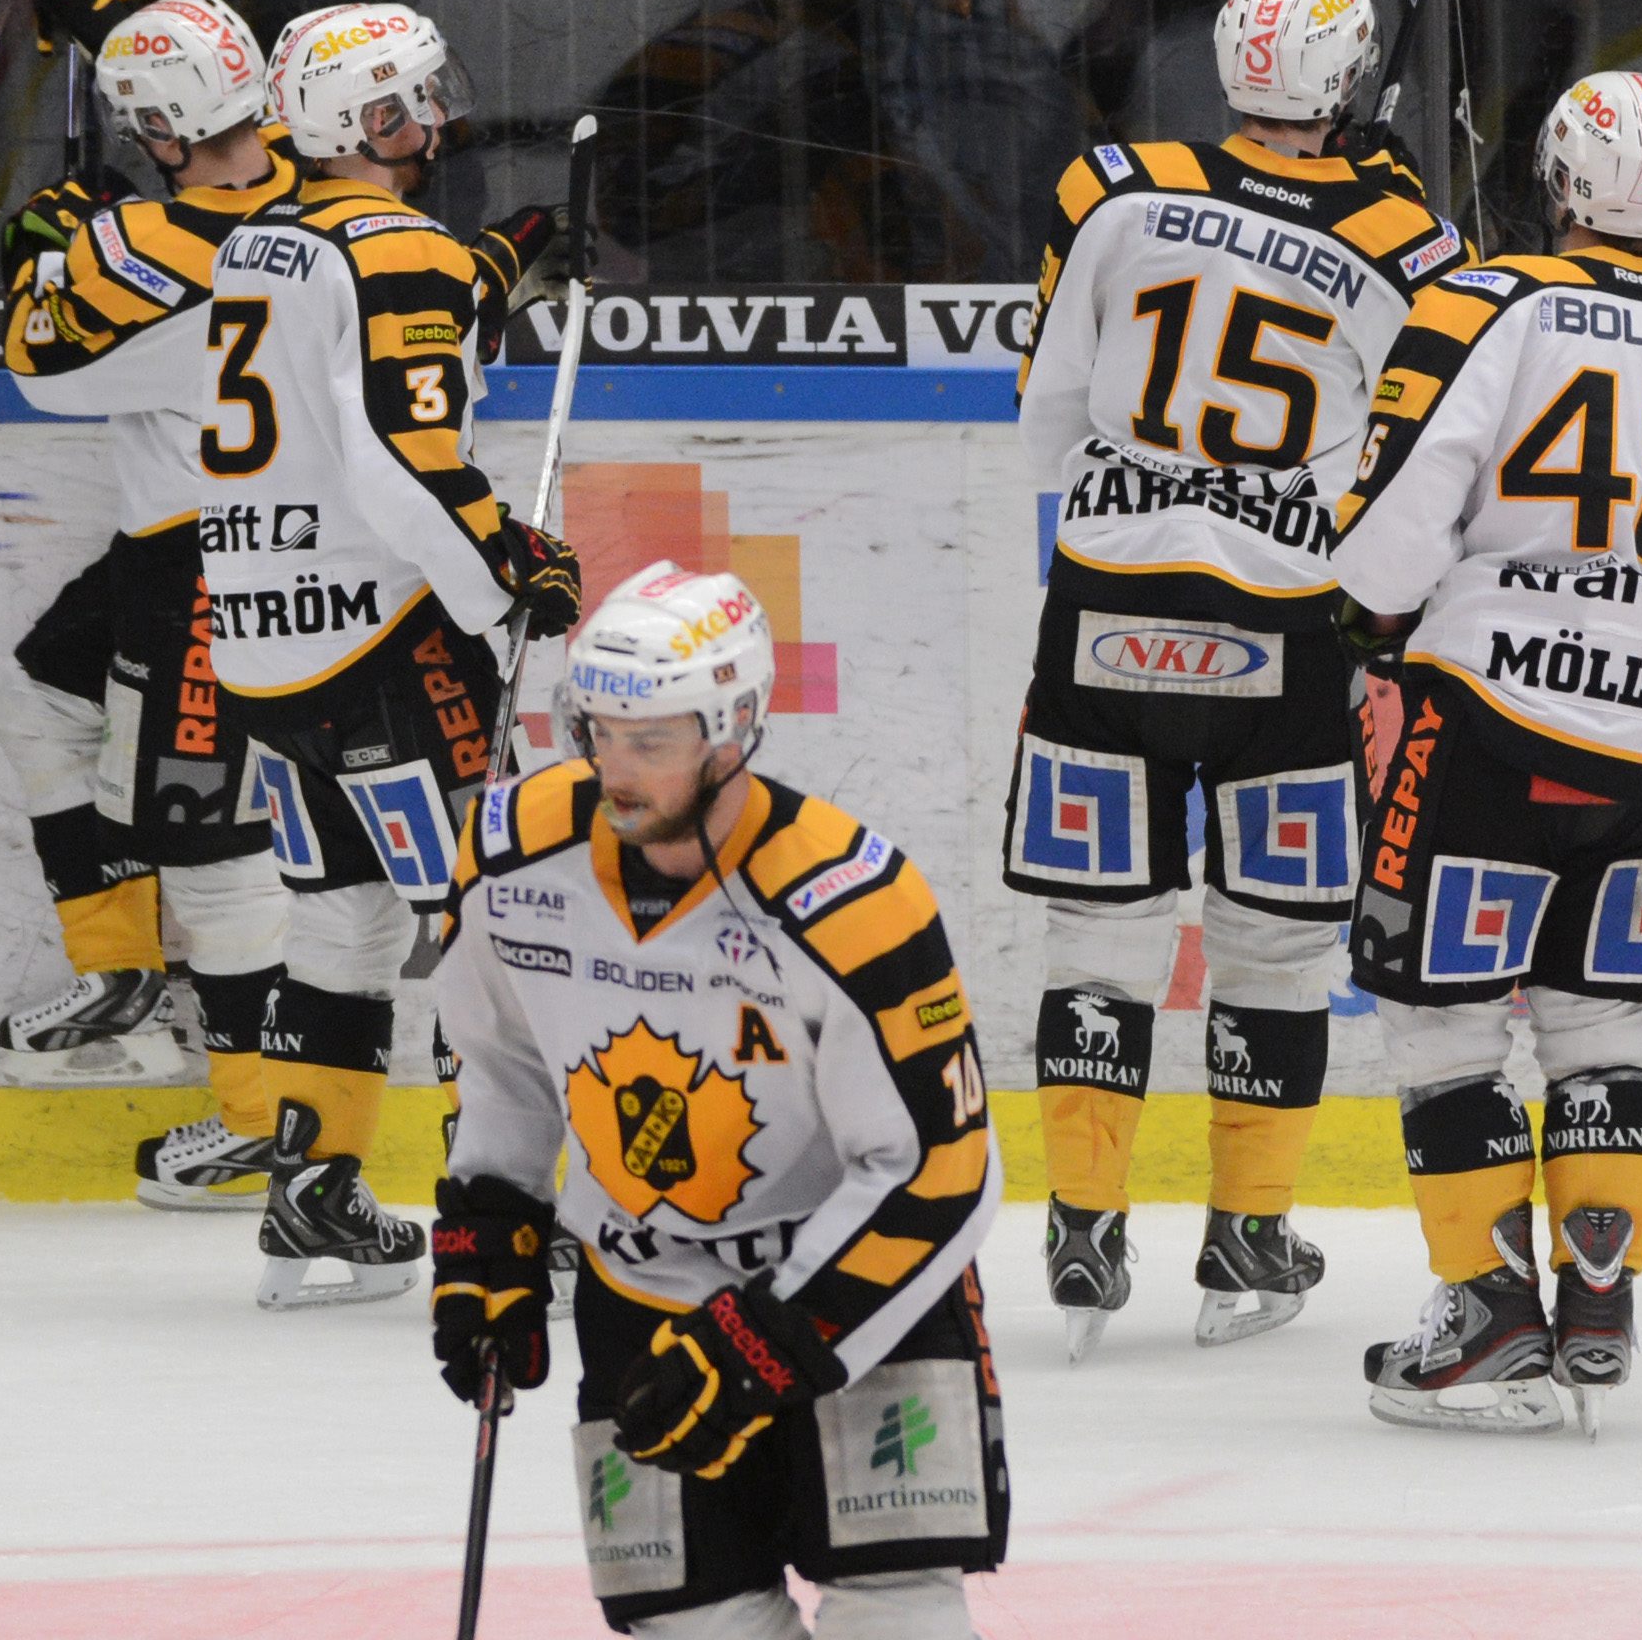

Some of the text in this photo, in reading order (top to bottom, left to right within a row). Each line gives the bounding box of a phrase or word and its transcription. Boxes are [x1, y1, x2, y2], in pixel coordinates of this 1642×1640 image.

[312, 15, 410, 62] skebo
[1305, 24, 1338, 45] CCM
[301, 61, 343, 81] CCM
[371, 61, 398, 83] XL
[1245, 30, 1276, 85] ICA
[1323, 71, 1340, 94] 15
[168, 101, 184, 119] 9
[337, 109, 353, 128] 3
[1583, 122, 1613, 145] CCM
[1239, 176, 1313, 210] Reebok
[1573, 175, 1593, 200] 45
[1157, 202, 1368, 310] BOLIDEN
[523, 296, 897, 355] VOLVIA
[1538, 294, 1552, 335] NEW
[200, 294, 282, 480] 3
[1131, 274, 1338, 468] 15
[405, 364, 448, 422] 3
[1064, 466, 1338, 562] KARLSSON
[1114, 635, 1232, 677] NKL
[570, 662, 653, 701] AllTele
[411, 628, 491, 779] REPA
[343, 744, 391, 767] CCM
[1373, 696, 1445, 891] REPAY
[592, 957, 695, 993] BOLIDEN
[733, 1003, 788, 1064] A
[1044, 1056, 1142, 1088] NORRAN
[708, 1290, 795, 1395] Reebok
[835, 1484, 979, 1517] martinsons
